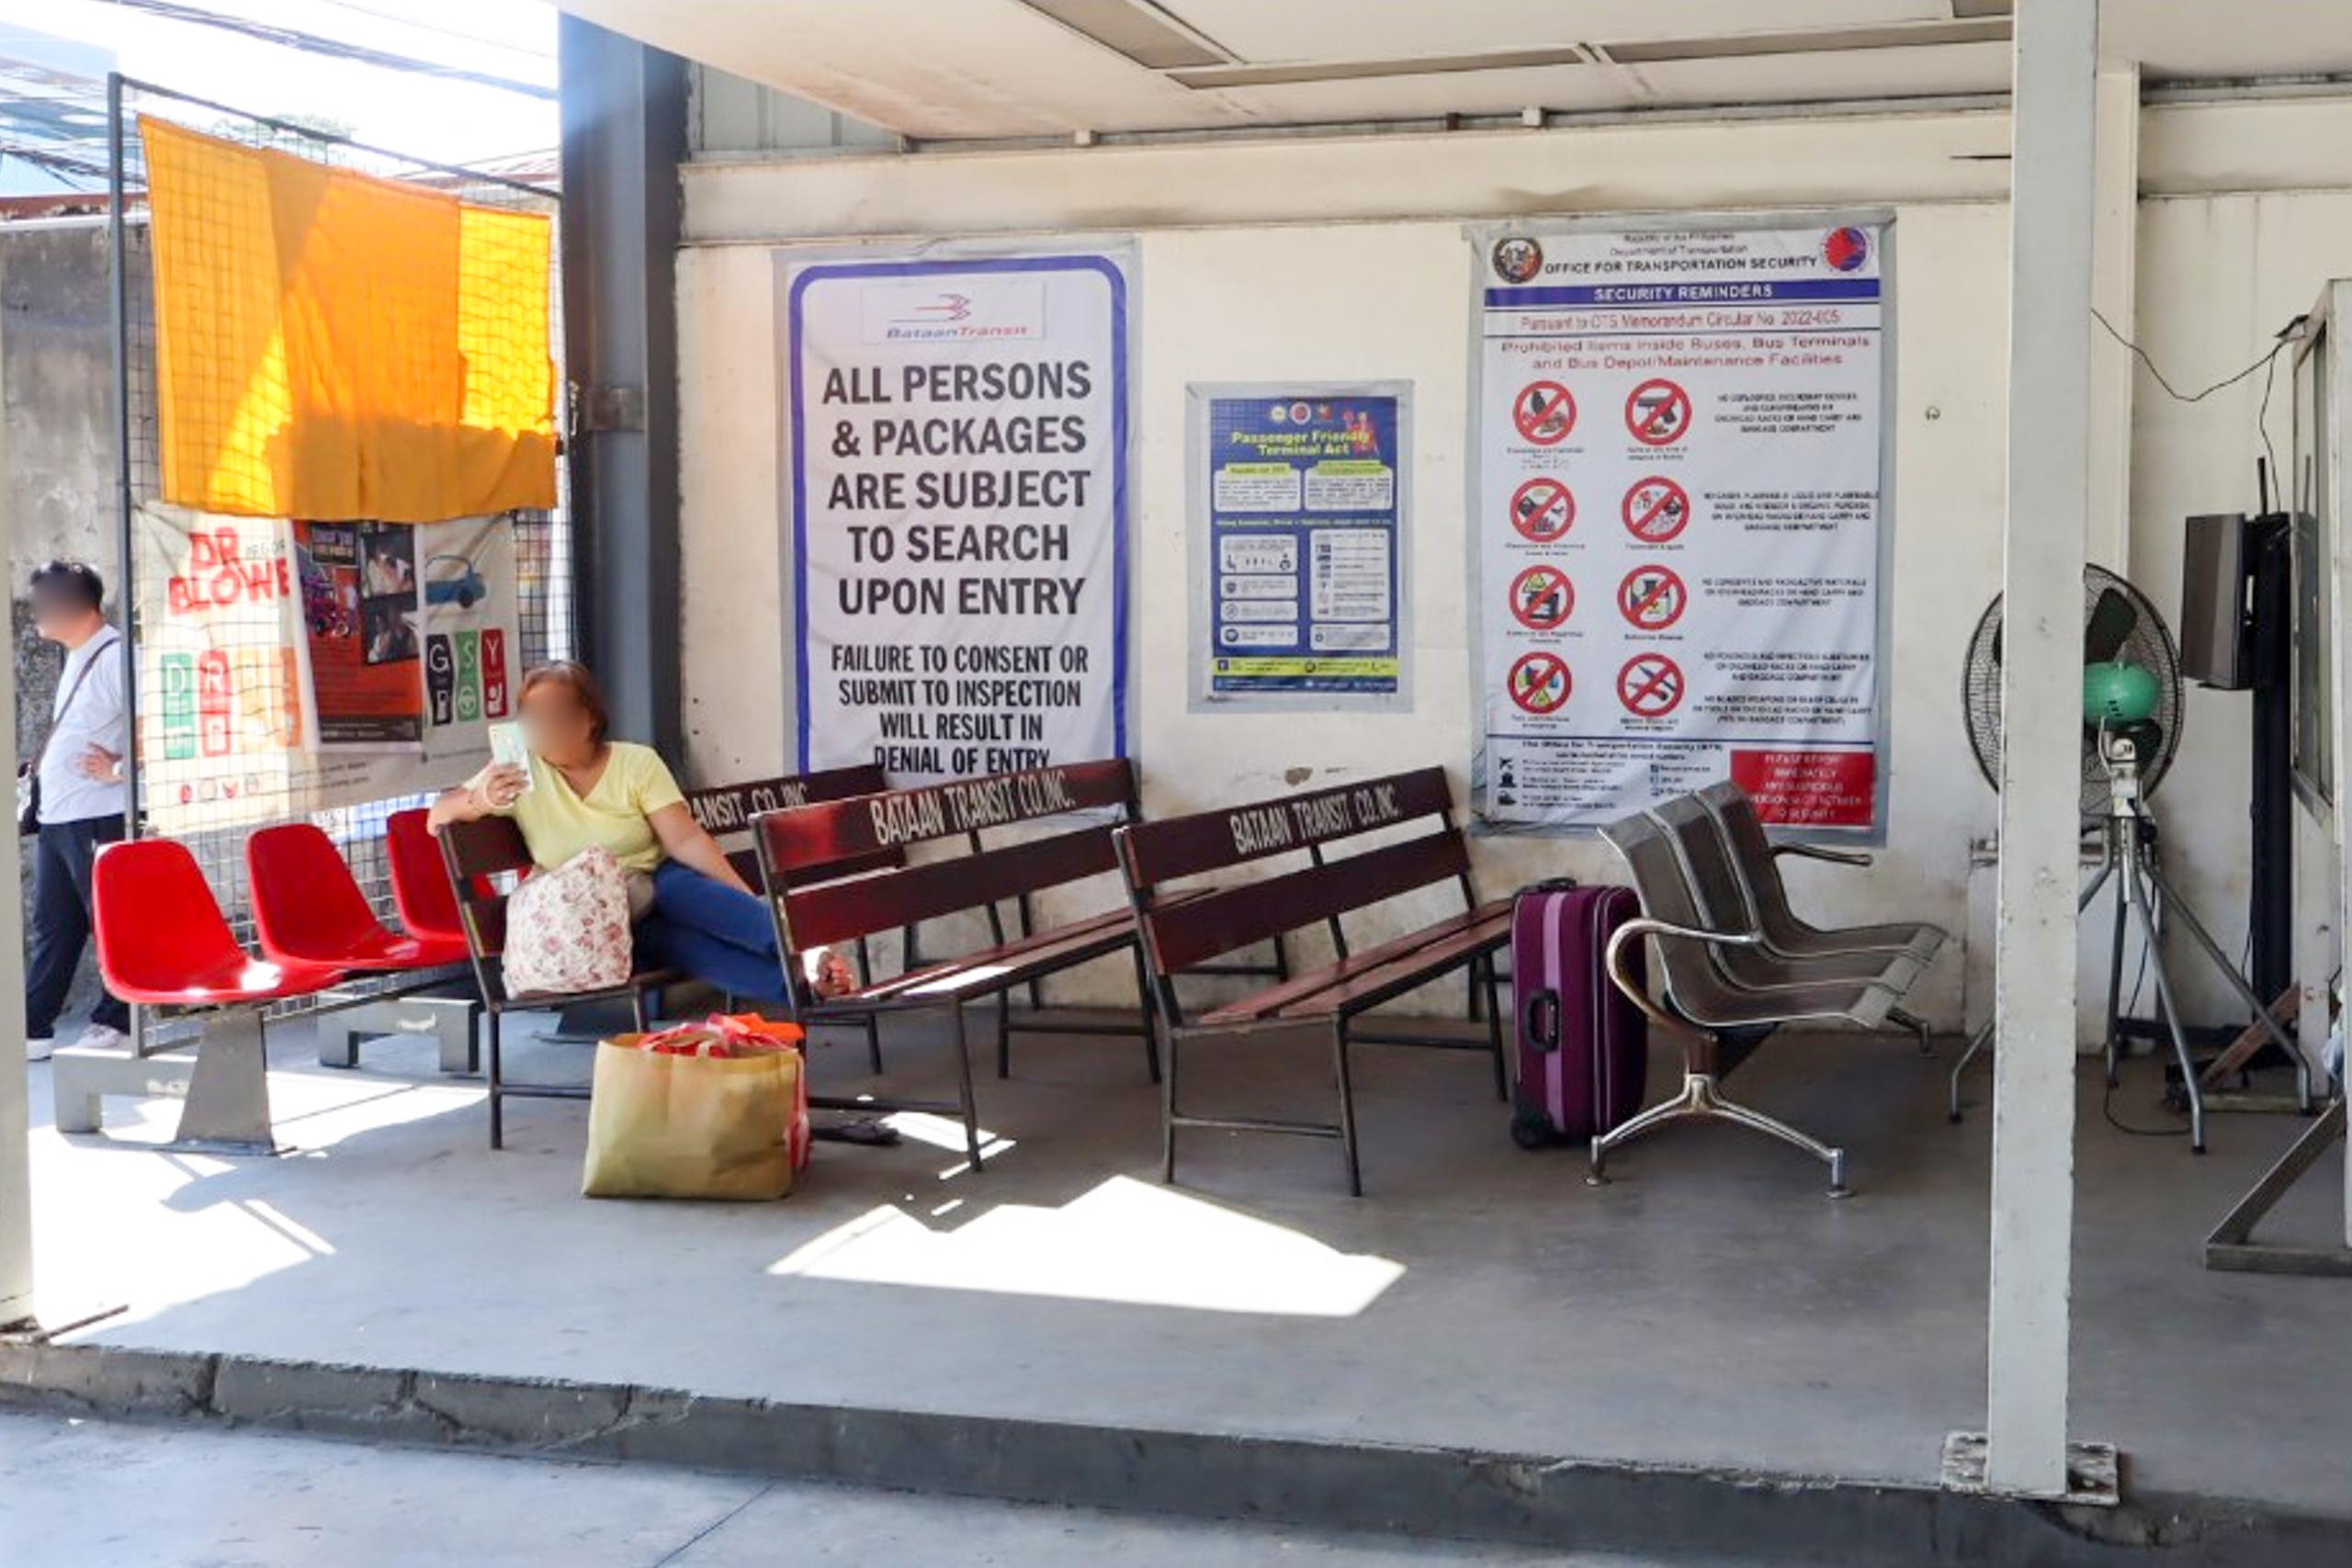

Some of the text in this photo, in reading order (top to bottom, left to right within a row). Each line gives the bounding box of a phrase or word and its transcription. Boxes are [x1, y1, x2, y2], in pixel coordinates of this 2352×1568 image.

[1545, 255, 1816, 274] OFFICE FOR TRANSPORTATION SECURITY
[1594, 284, 1773, 301] SECURITY REMINDERS
[1622, 312, 1702, 329] Memorandum
[1706, 311, 1752, 327] Circular
[1501, 340, 1583, 354] Prohibited
[1637, 339, 1684, 351] inside
[1753, 336, 1784, 349] Bus
[1792, 335, 1870, 348] Terminals
[1533, 356, 1562, 369] and
[1568, 356, 1598, 369] Bus
[1770, 353, 1843, 366] Facilities
[822, 360, 1091, 404] ALL PERSONS
[831, 415, 1086, 457] & PACKAGES
[1231, 430, 1370, 446] Passenger Friendly
[1259, 443, 1350, 456] Terminal Act
[828, 470, 1091, 510] ARE SUBJECT
[189, 526, 239, 570] DR
[847, 525, 1069, 563] TO SEARCH
[839, 578, 1086, 615] UPON ENTRY
[430, 637, 499, 671] G S Y
[831, 645, 1088, 673] FAILURE TO CONSENT OR
[839, 680, 1080, 707] SUBMIT TO INSPECTION
[879, 713, 1043, 741] WILL RESULT IN
[875, 746, 1050, 774] DENIAL OF ENTRY
[692, 792, 746, 829] ANSIT
[870, 789, 944, 845] BATAAN
[944, 777, 1016, 829] TRANSIT
[1229, 806, 1293, 854] BATAAN
[1292, 792, 1352, 840] TRANSIT
